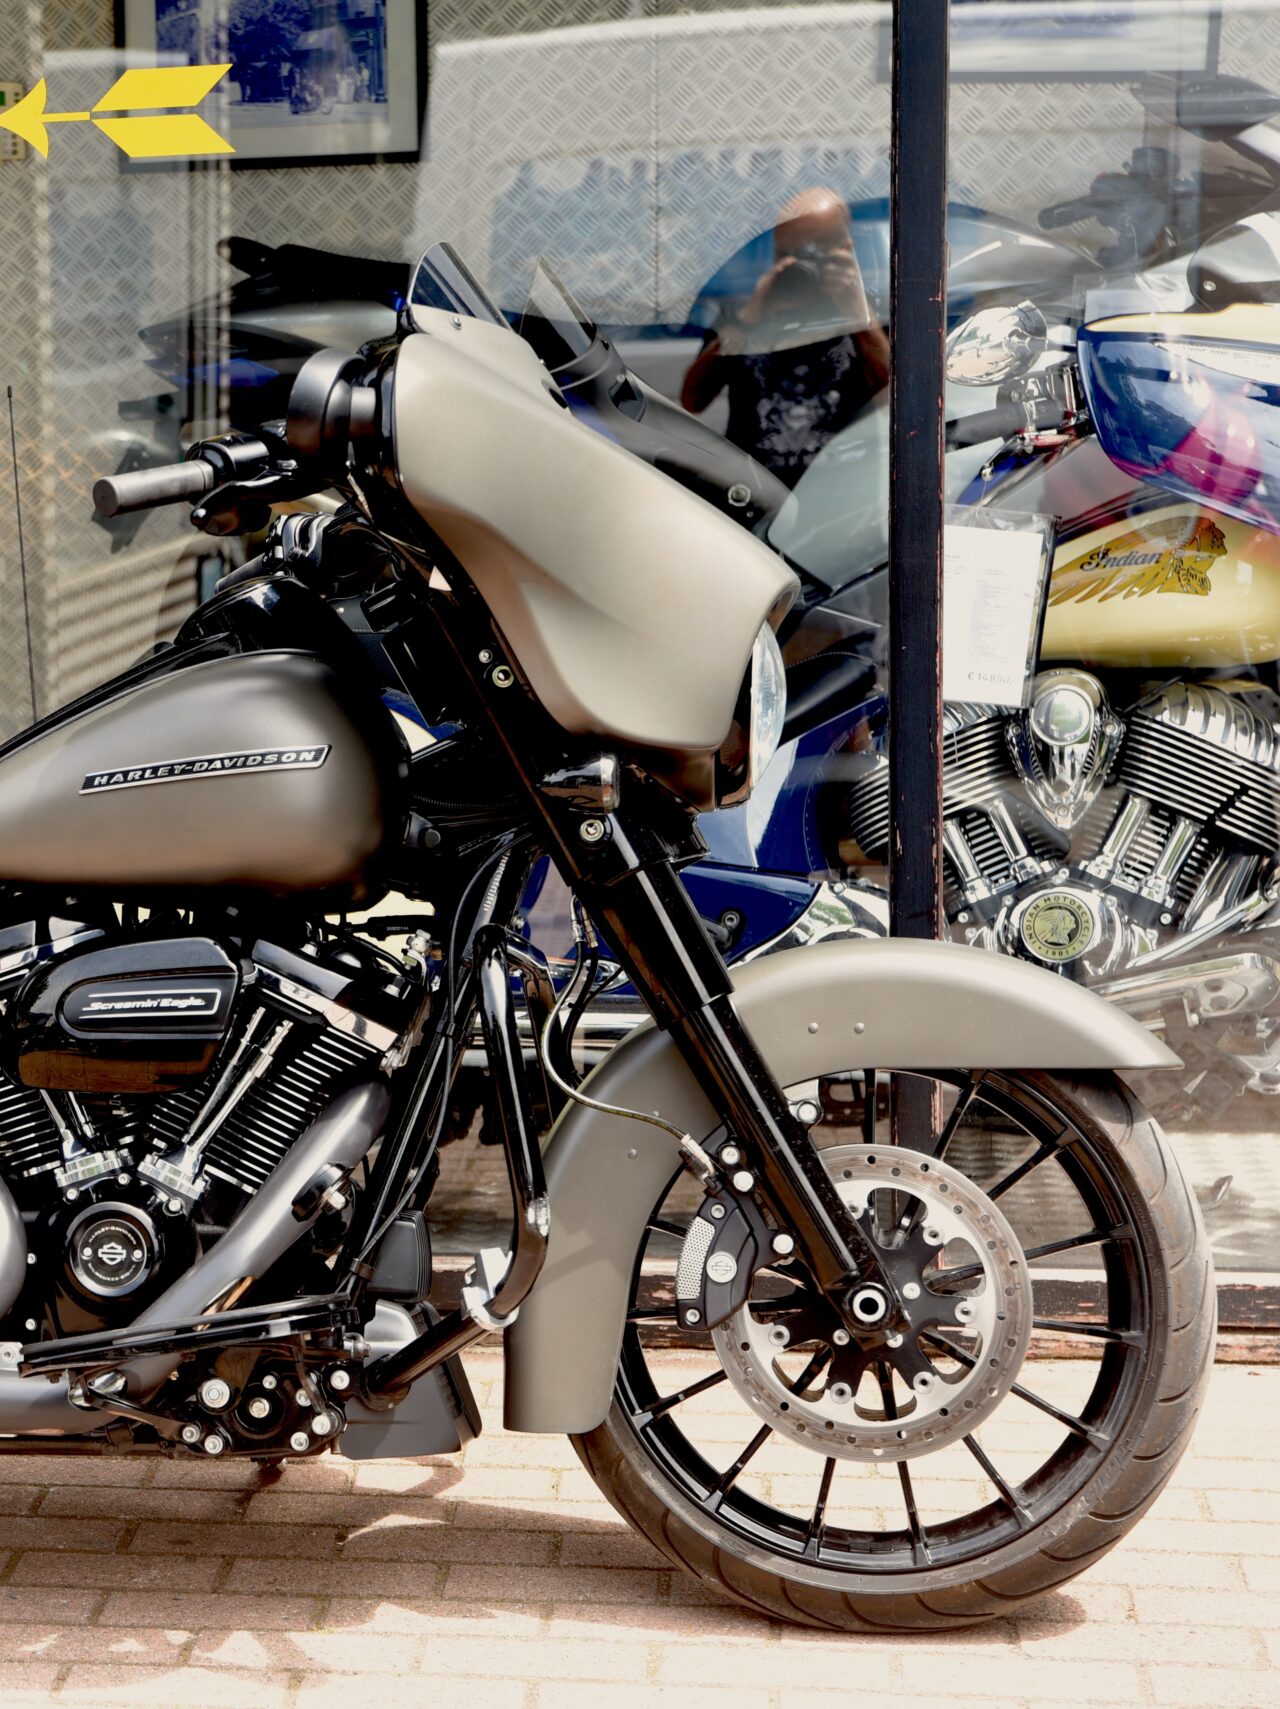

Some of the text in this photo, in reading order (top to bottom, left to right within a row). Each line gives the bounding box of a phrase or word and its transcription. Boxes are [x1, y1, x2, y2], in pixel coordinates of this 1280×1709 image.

[1080, 548, 1163, 571] Indian
[94, 751, 315, 786] HARLEY-DAVIDSON
[1026, 896, 1089, 945] INDIAN MOTORCYCLE
[1045, 949, 1069, 957] 1901
